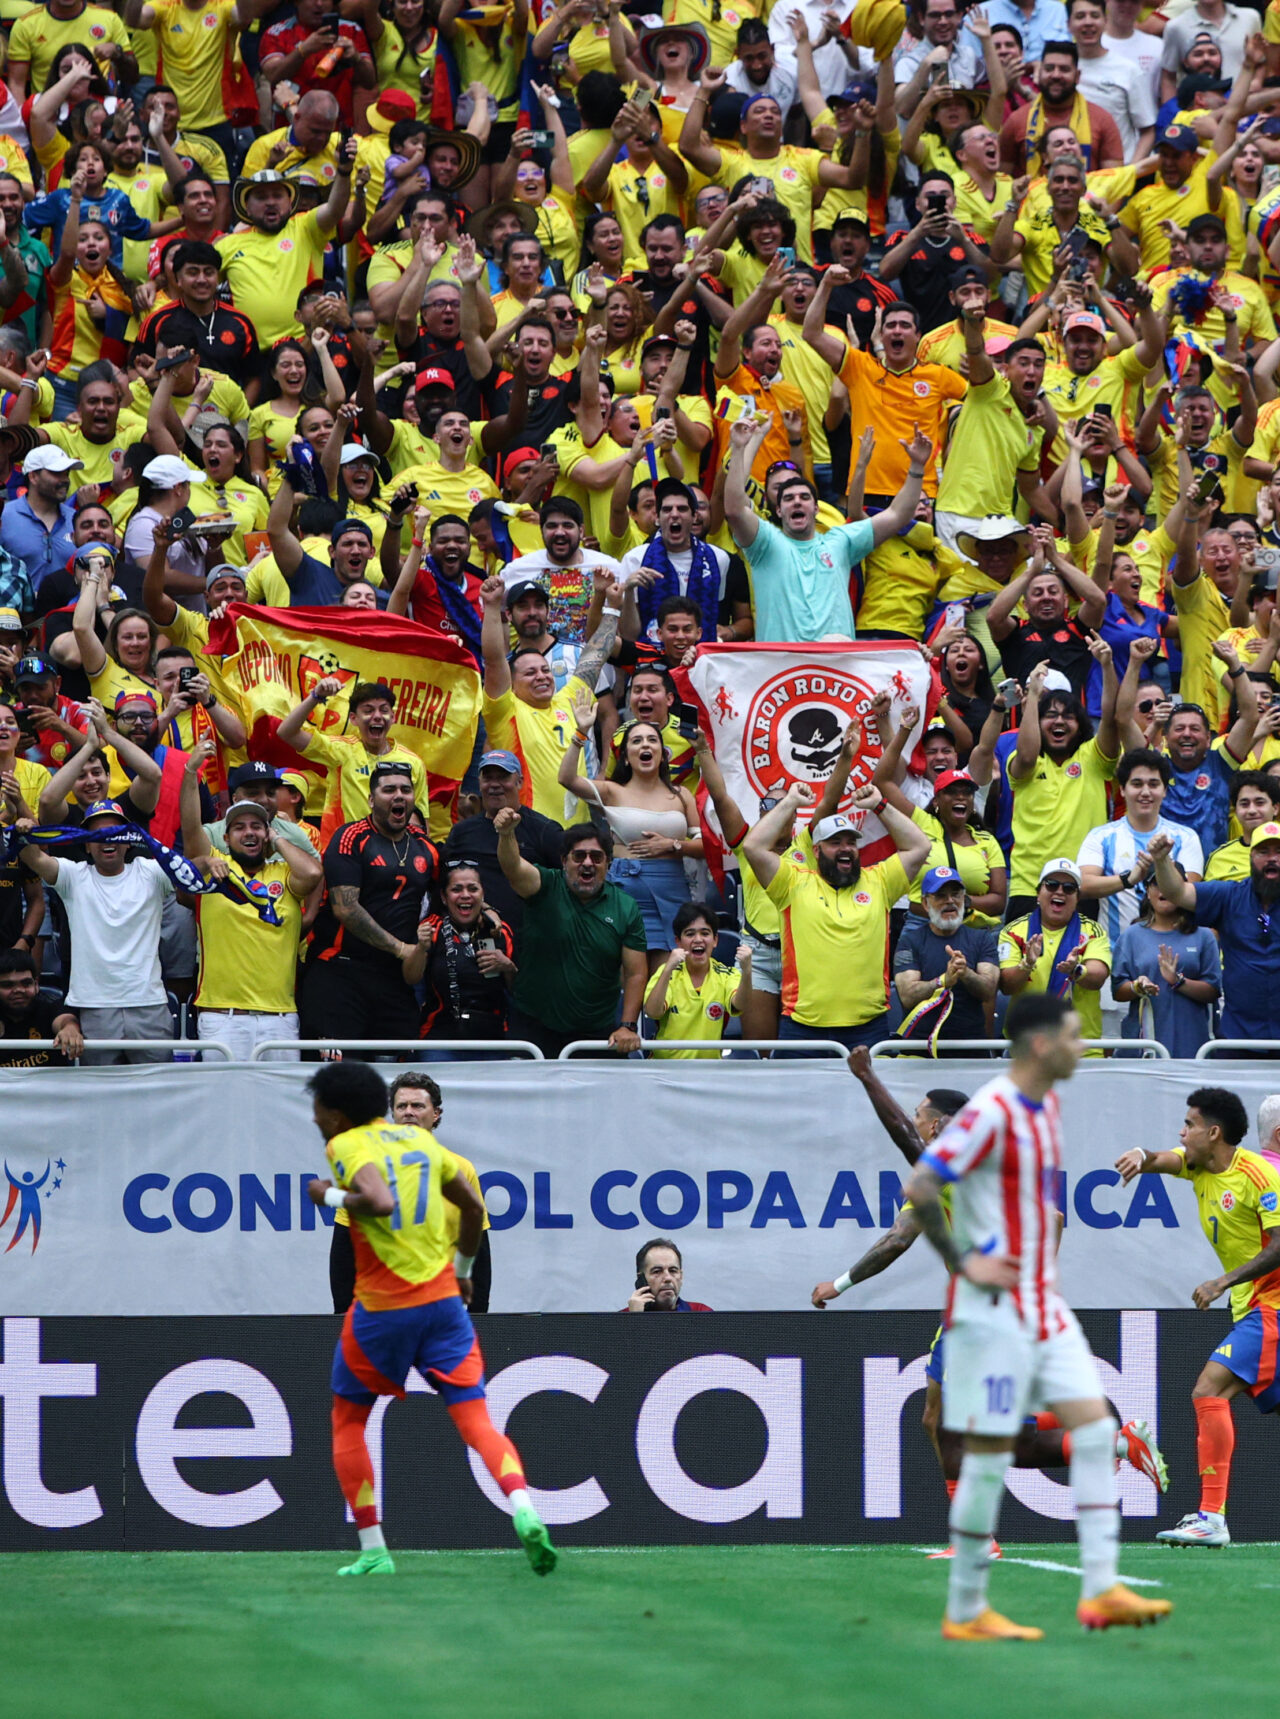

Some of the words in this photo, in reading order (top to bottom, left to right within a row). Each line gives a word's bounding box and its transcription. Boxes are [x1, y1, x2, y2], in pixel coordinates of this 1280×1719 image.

[752, 686, 790, 769] BARON
[794, 677, 857, 703] ROJO
[856, 699, 881, 747] SUR
[392, 875, 407, 900] 7
[384, 1150, 430, 1230] 17
[590, 1169, 807, 1230] COPA
[1208, 1216, 1218, 1244] 7
[982, 1375, 1013, 1415] 10
